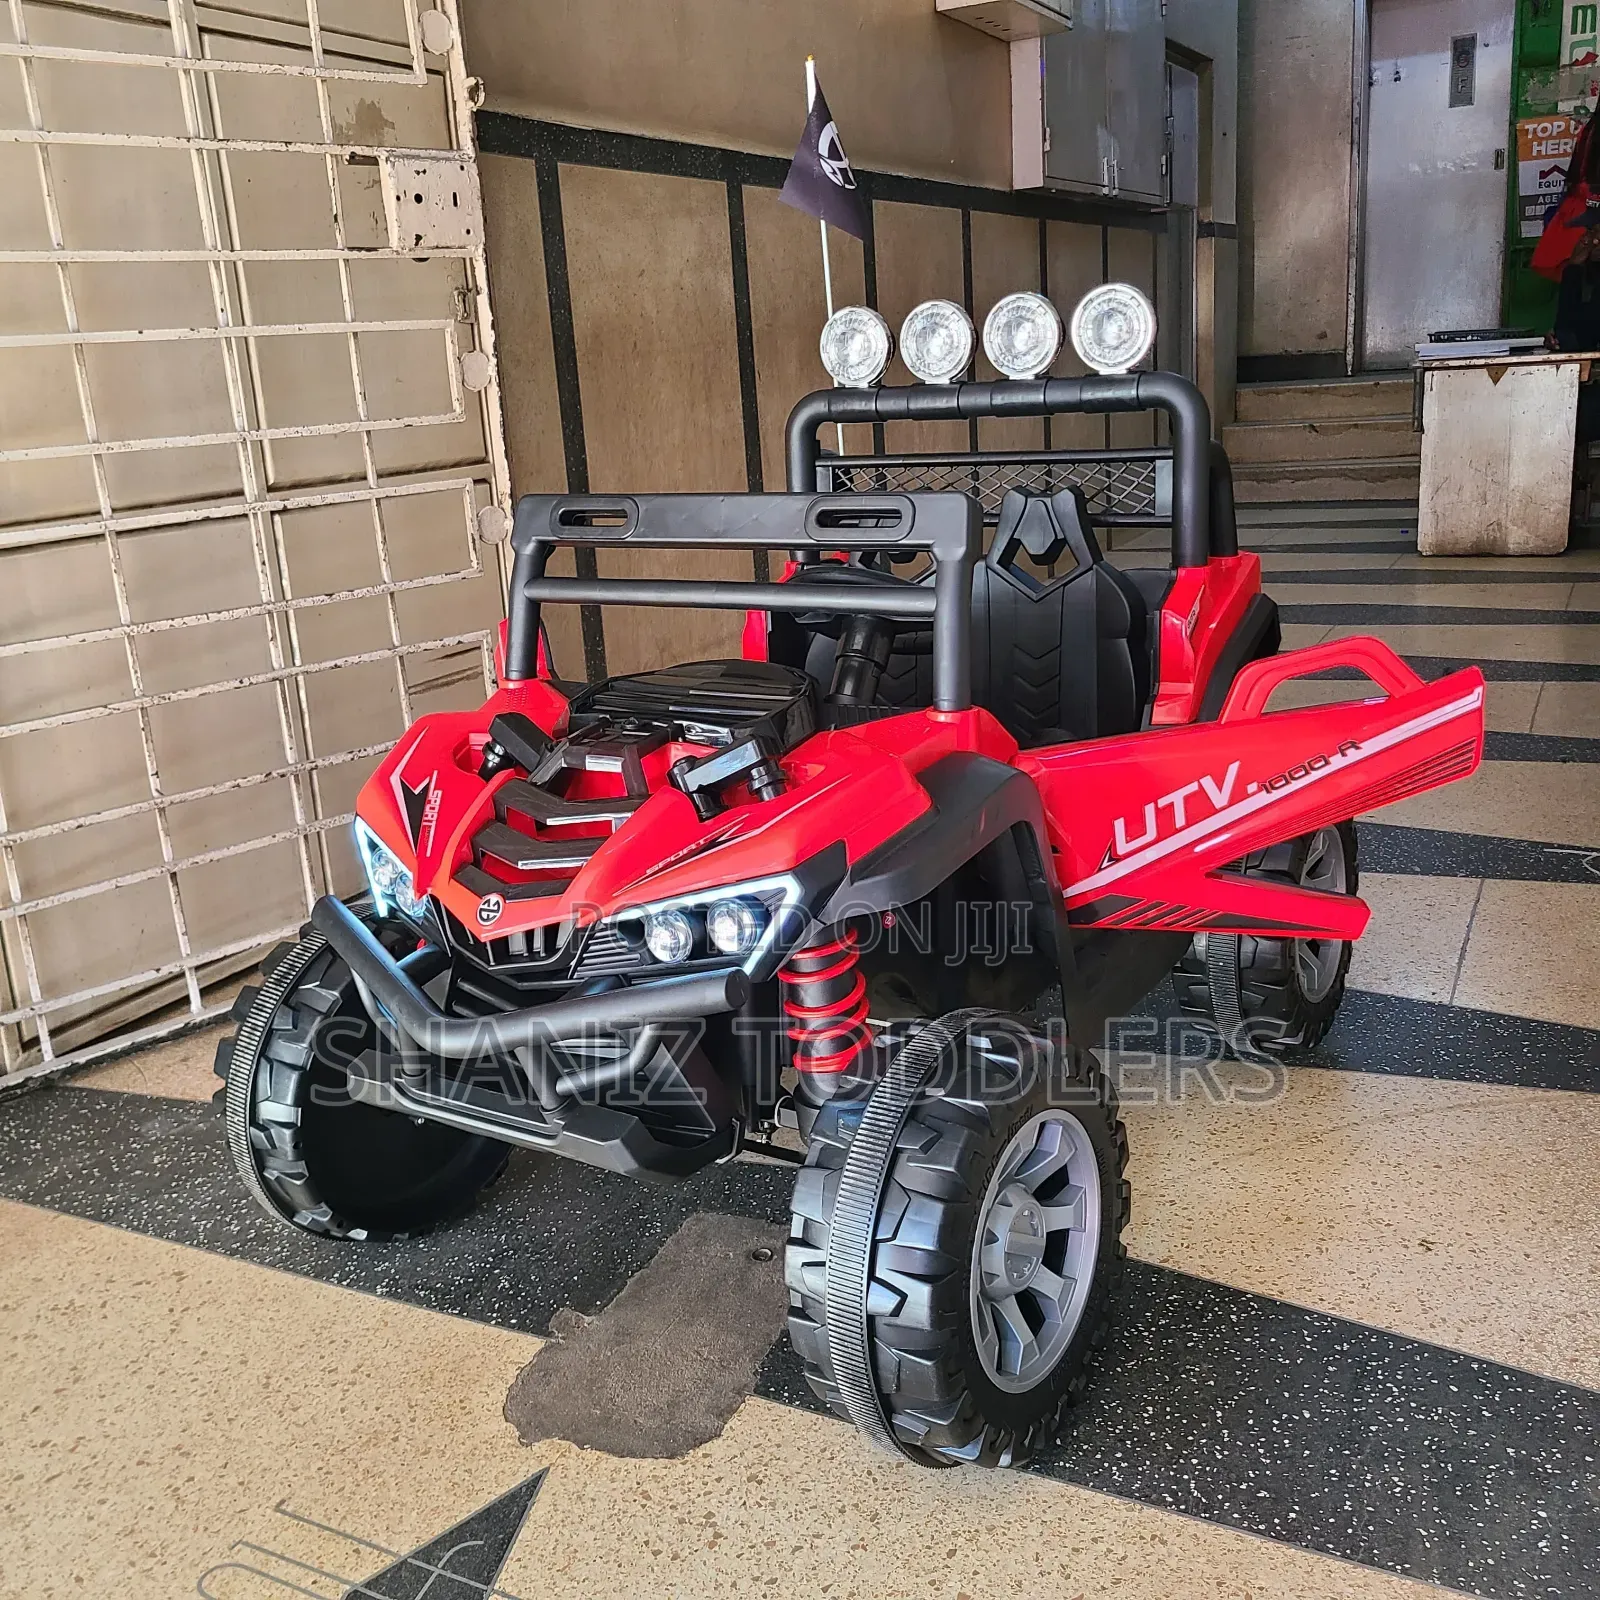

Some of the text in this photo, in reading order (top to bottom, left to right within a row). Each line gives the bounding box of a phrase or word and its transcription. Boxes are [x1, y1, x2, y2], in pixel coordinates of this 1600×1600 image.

[1525, 121, 1566, 139] TOP
[1532, 138, 1578, 156] HER
[1538, 180, 1567, 189] EQUIT
[1538, 194, 1561, 204] AGE
[1260, 753, 1331, 794] 1000
[1337, 740, 1363, 758] R
